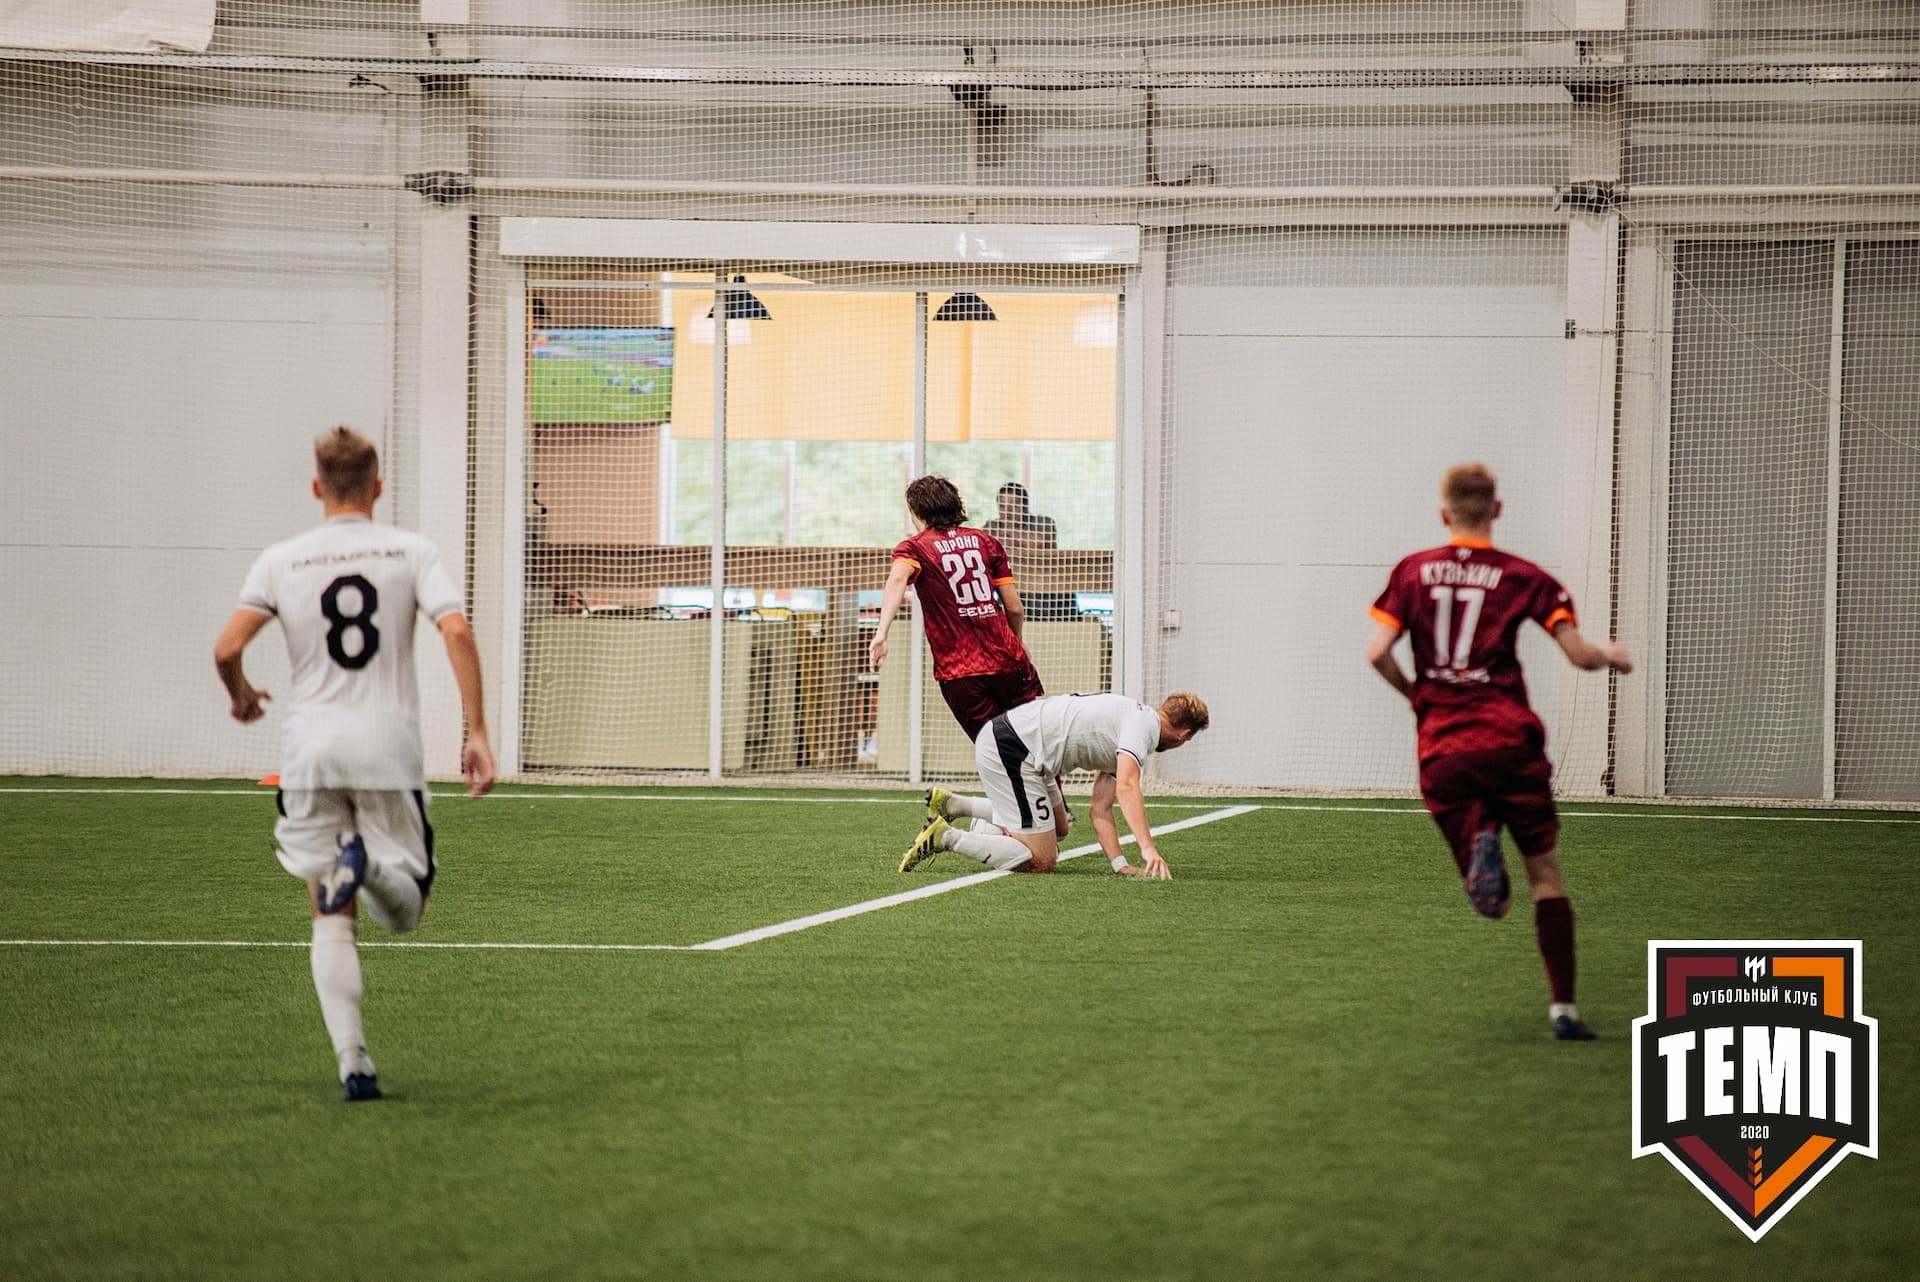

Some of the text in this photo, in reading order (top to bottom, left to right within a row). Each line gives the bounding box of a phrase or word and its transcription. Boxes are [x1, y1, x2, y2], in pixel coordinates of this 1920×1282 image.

[934, 535, 980, 553] ВОРОНА
[941, 549, 992, 605] 23
[1420, 561, 1504, 590] КУЗЬКИН
[320, 574, 379, 670] 8
[1429, 585, 1486, 670] 17
[1035, 796, 1050, 821] 5
